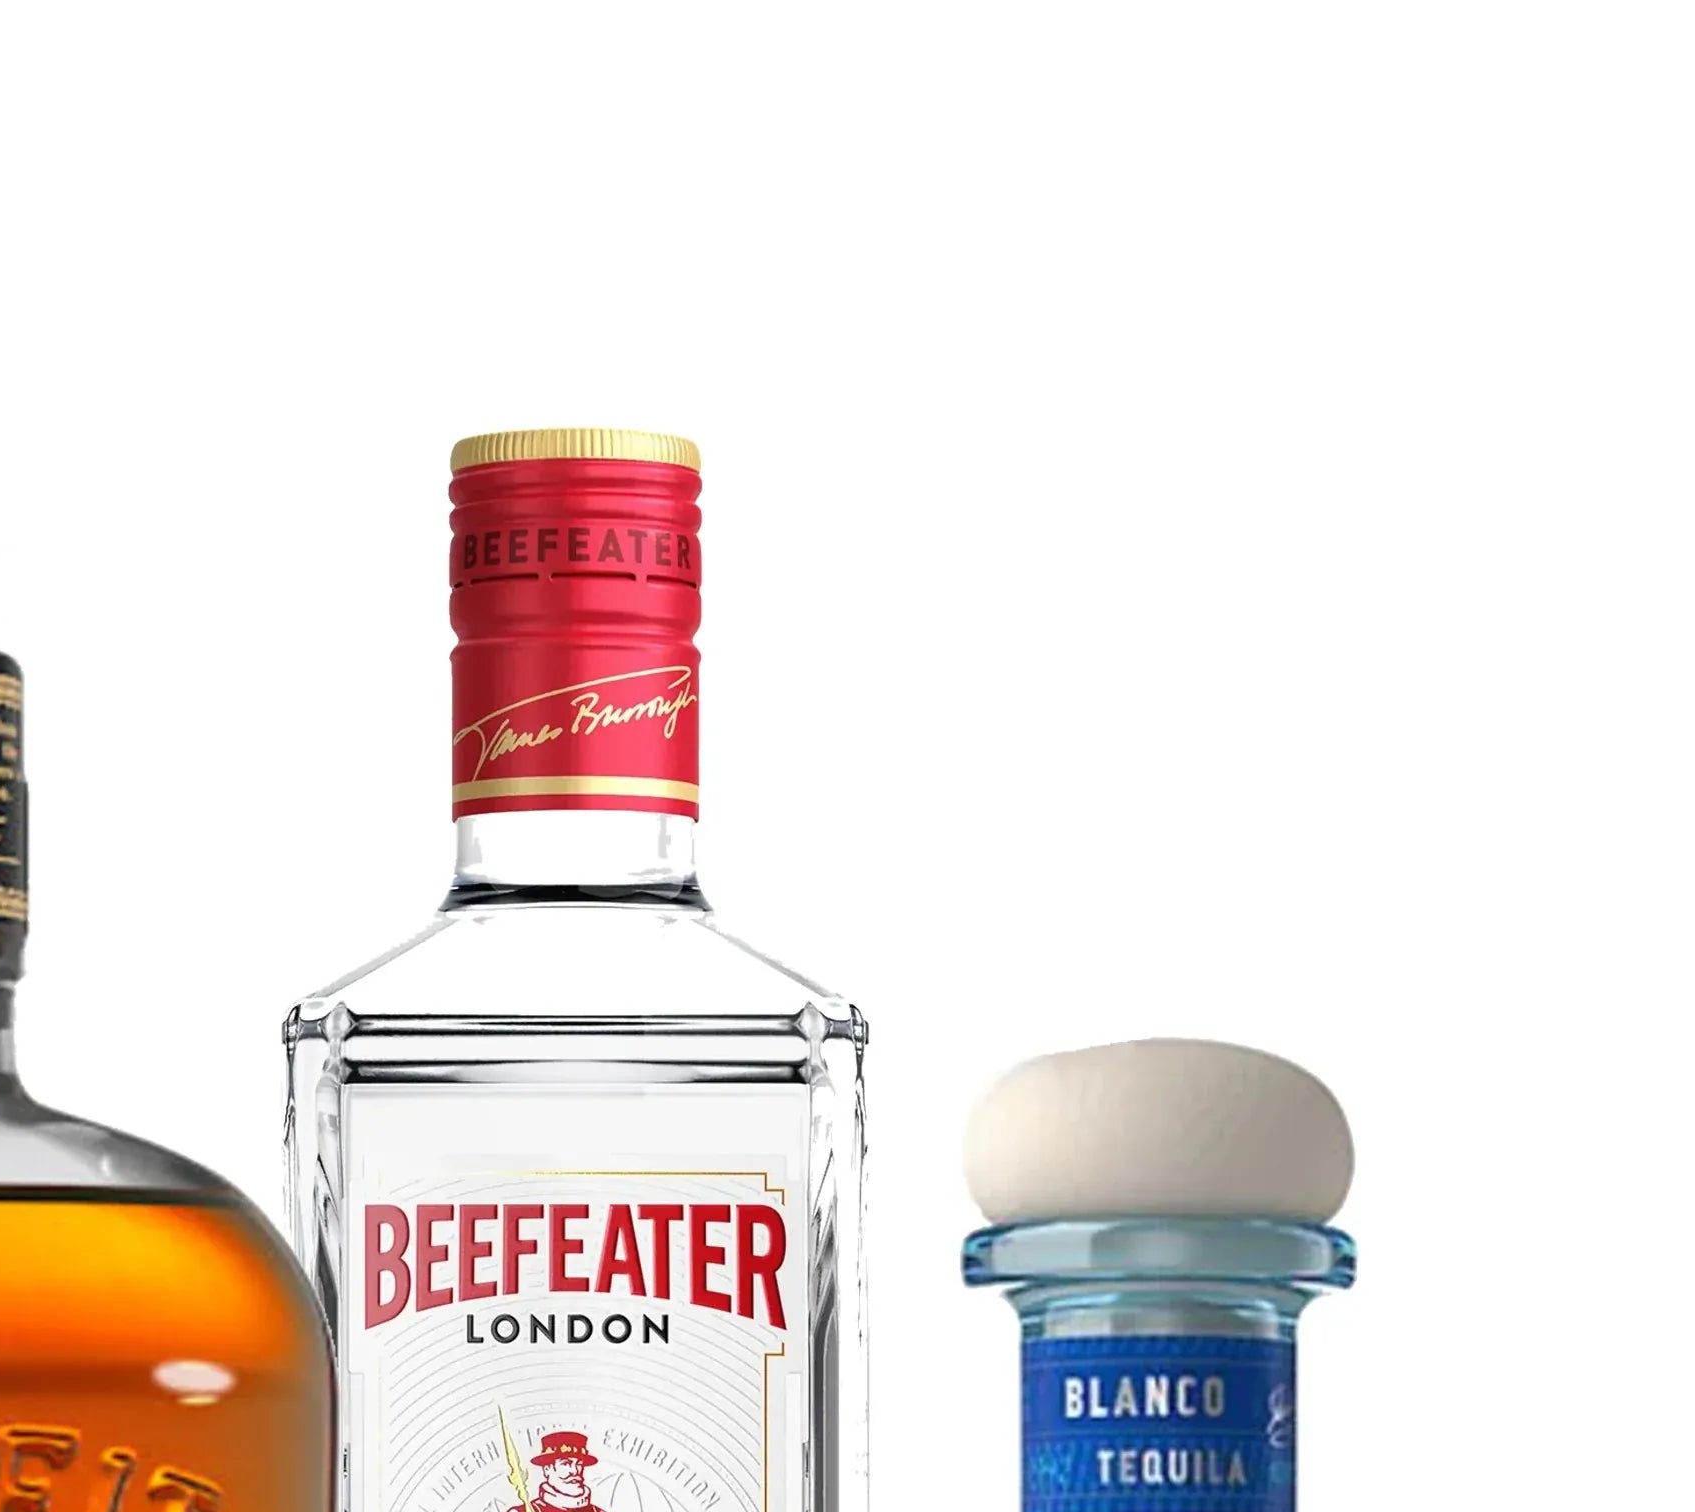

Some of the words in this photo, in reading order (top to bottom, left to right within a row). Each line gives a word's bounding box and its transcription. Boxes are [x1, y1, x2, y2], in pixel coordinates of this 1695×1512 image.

[463, 527, 692, 571] BEEFEATER
[364, 1203, 788, 1332] BEEFEATER
[465, 1313, 670, 1345] LONDON
[1065, 1374, 1225, 1420] BLANCO
[1097, 1448, 1248, 1487] TEQUILA
